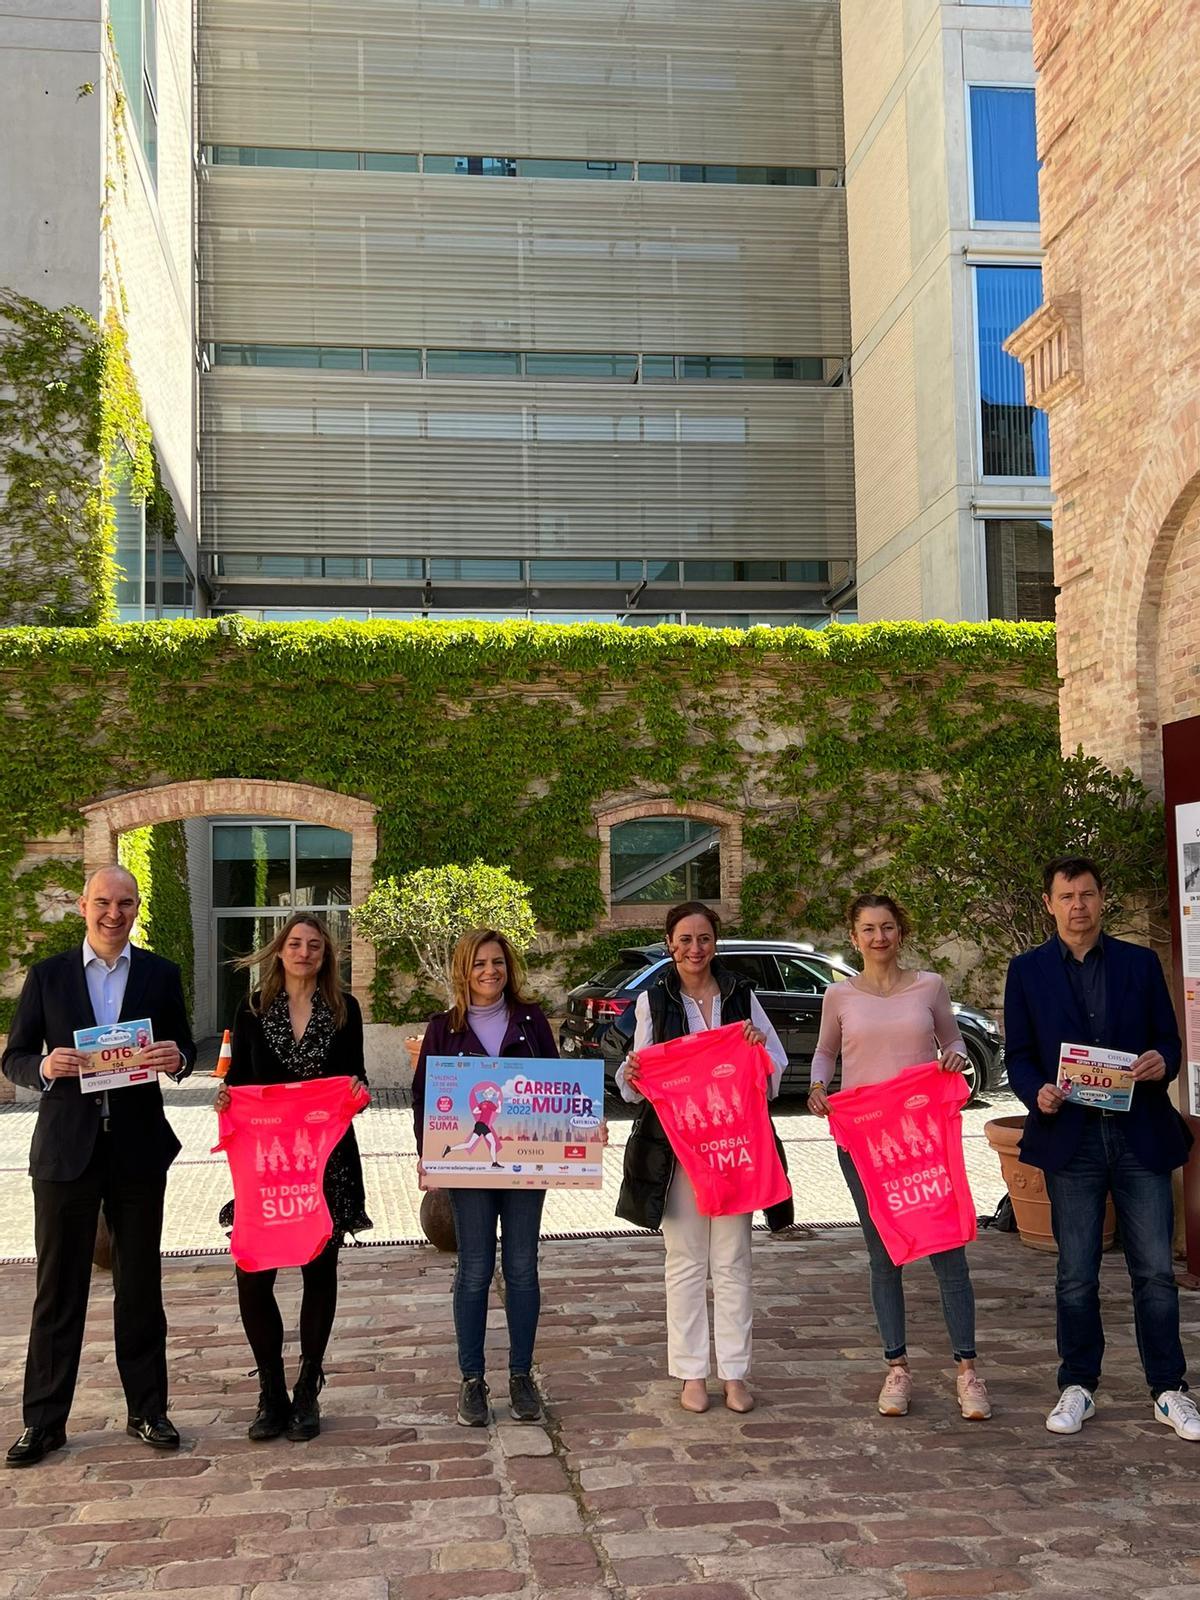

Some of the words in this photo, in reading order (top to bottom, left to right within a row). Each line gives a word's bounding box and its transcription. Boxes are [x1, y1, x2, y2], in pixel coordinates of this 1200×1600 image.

[101, 1046, 132, 1061] 016
[514, 1080, 582, 1096] CARRERA
[662, 1075, 691, 1090] OYSHO
[1081, 1074, 1113, 1088] 016
[507, 1105, 531, 1115] 2022
[532, 1097, 593, 1115] MUJER
[250, 1116, 282, 1125] OYSHO
[853, 1110, 883, 1125] OYSHO
[429, 1121, 459, 1131] SUMA
[700, 1135, 751, 1153] DORSAL
[517, 1148, 545, 1156] OYSHO
[260, 1187, 277, 1198] TU
[882, 1180, 900, 1193] TU
[887, 1175, 953, 1211] SUMA
